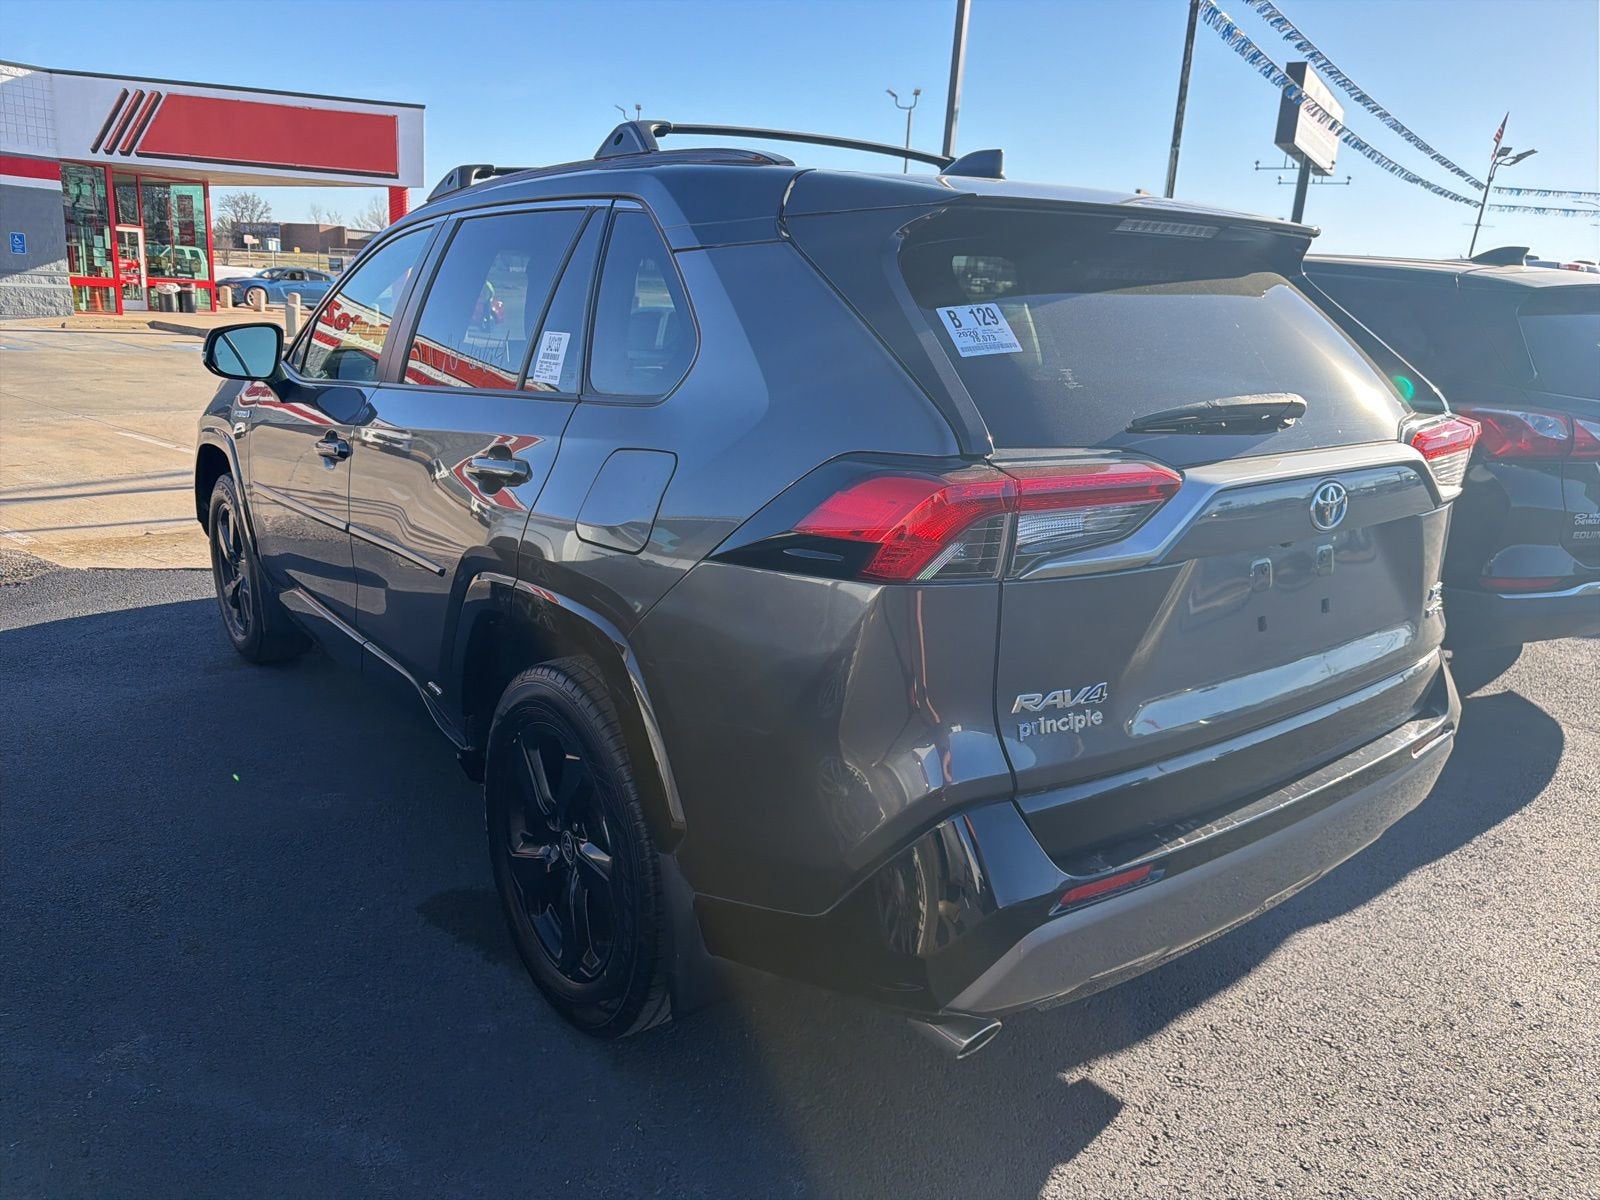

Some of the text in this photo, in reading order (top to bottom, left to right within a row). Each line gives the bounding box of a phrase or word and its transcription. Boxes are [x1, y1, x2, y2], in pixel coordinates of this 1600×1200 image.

[946, 306, 999, 328] B 129
[956, 330, 978, 338] 2020
[1011, 682, 1108, 714] RAV4
[1018, 709, 1104, 741] principle
